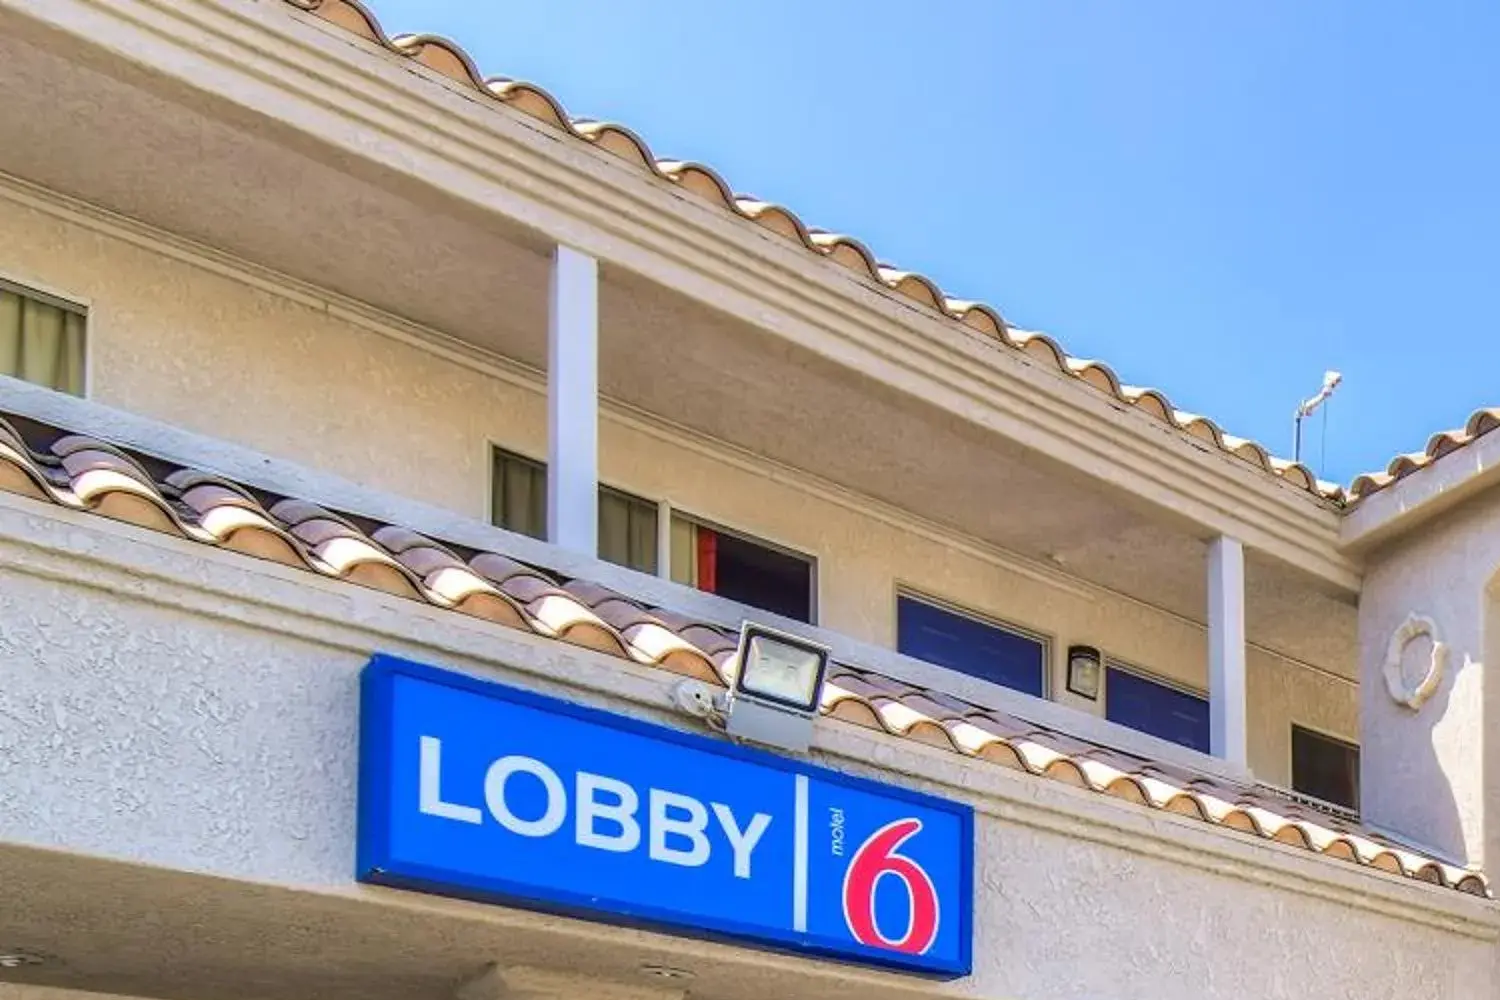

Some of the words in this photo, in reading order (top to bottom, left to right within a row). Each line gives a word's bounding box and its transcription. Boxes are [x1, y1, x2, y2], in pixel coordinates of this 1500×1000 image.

[418, 735, 773, 878] LOBBY
[828, 807, 845, 857] motel
[842, 817, 941, 955] 6
